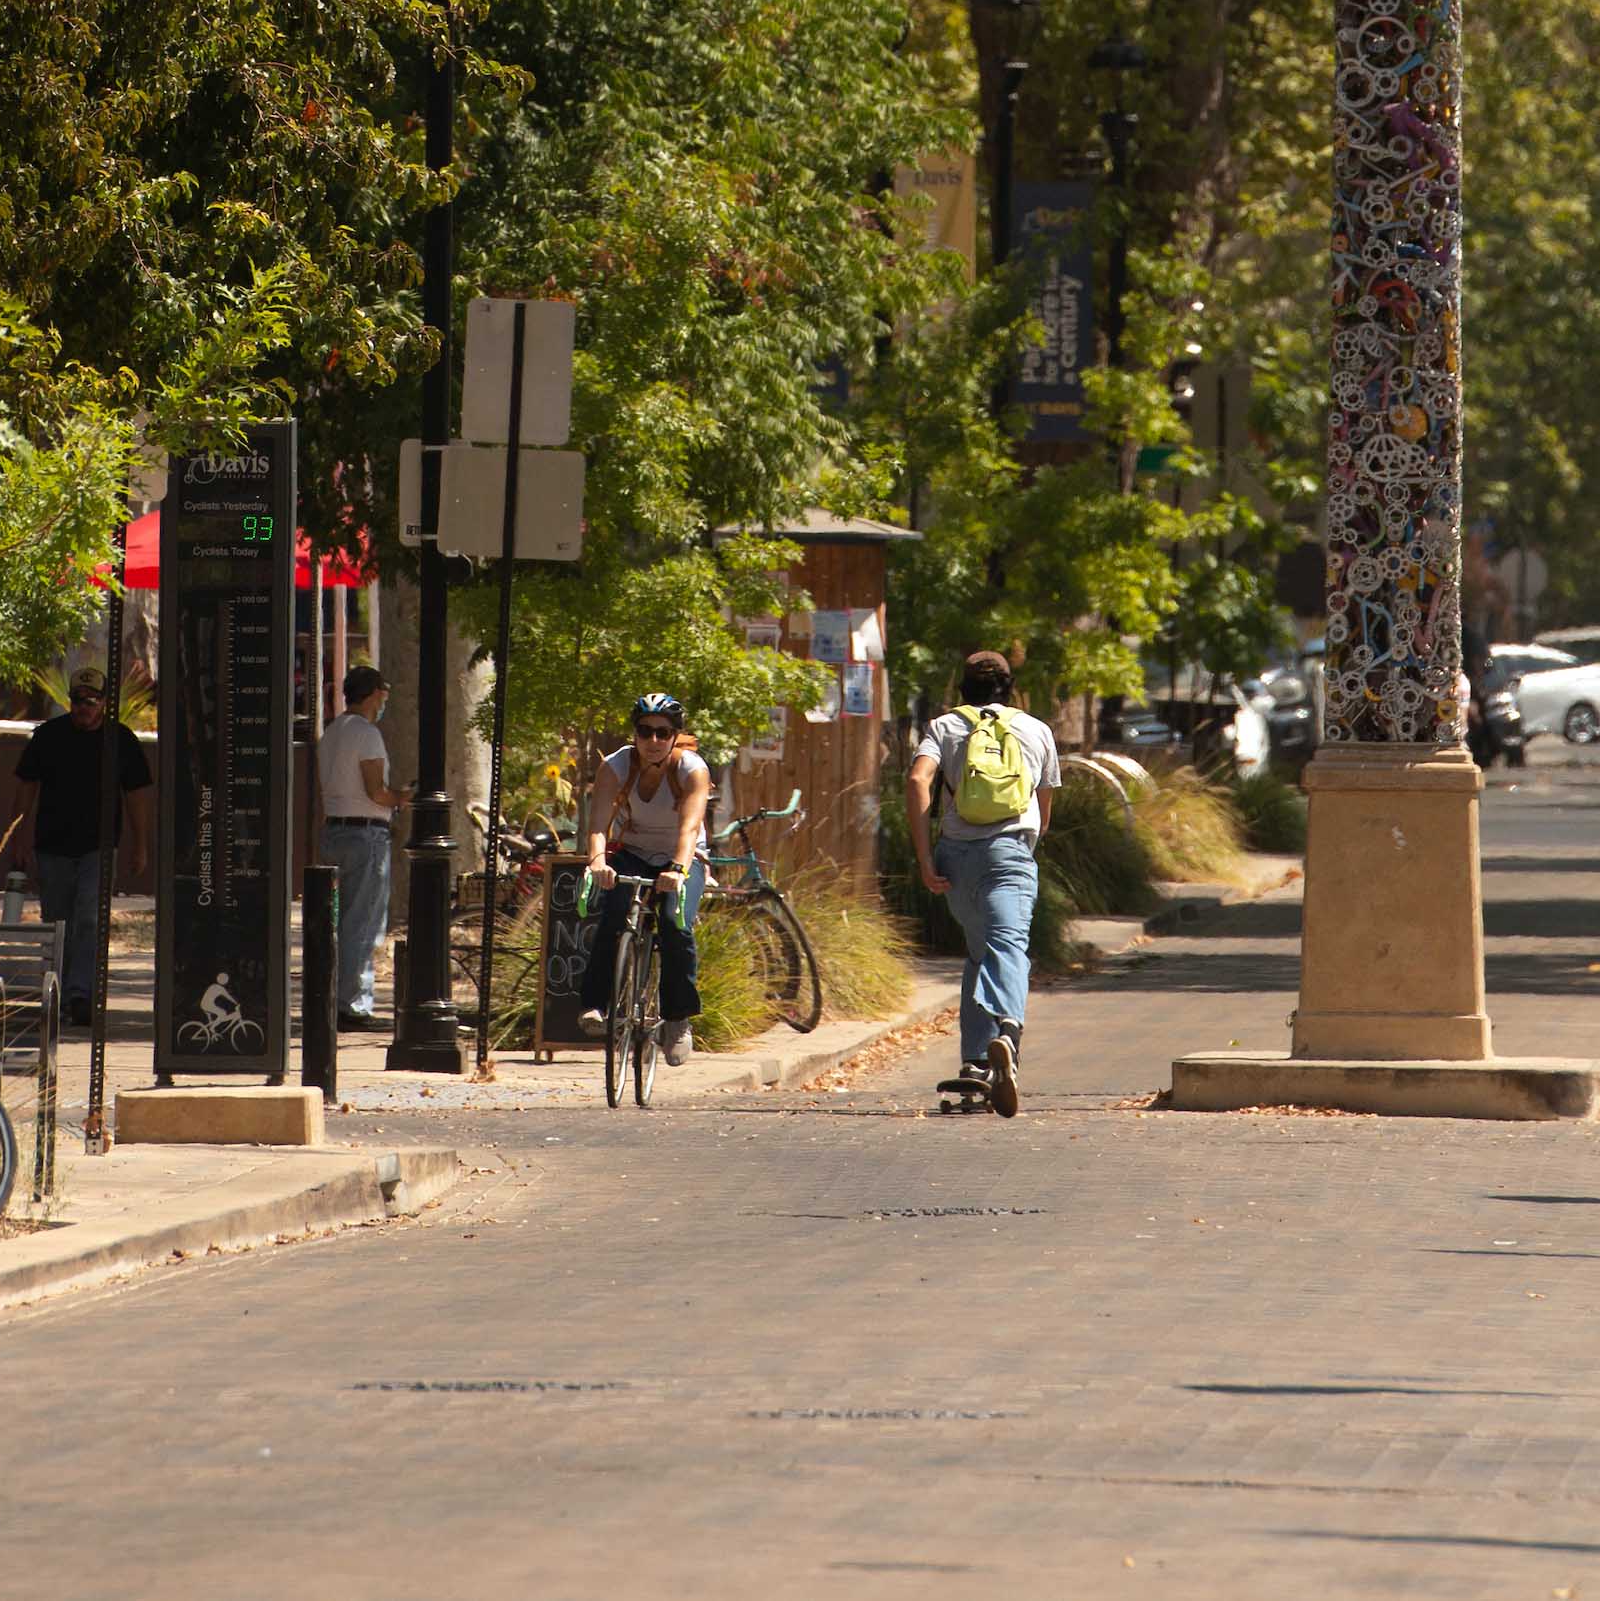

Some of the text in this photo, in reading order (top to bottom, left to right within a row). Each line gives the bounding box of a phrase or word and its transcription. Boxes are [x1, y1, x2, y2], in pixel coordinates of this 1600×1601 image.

[1059, 275, 1083, 367] century
[207, 448, 270, 474] Davis
[183, 501, 269, 513] Cyclists Yesterday
[243, 515, 274, 541] 93
[193, 546, 259, 558] Cyclists Today
[198, 784, 214, 906] Cyclists this Year
